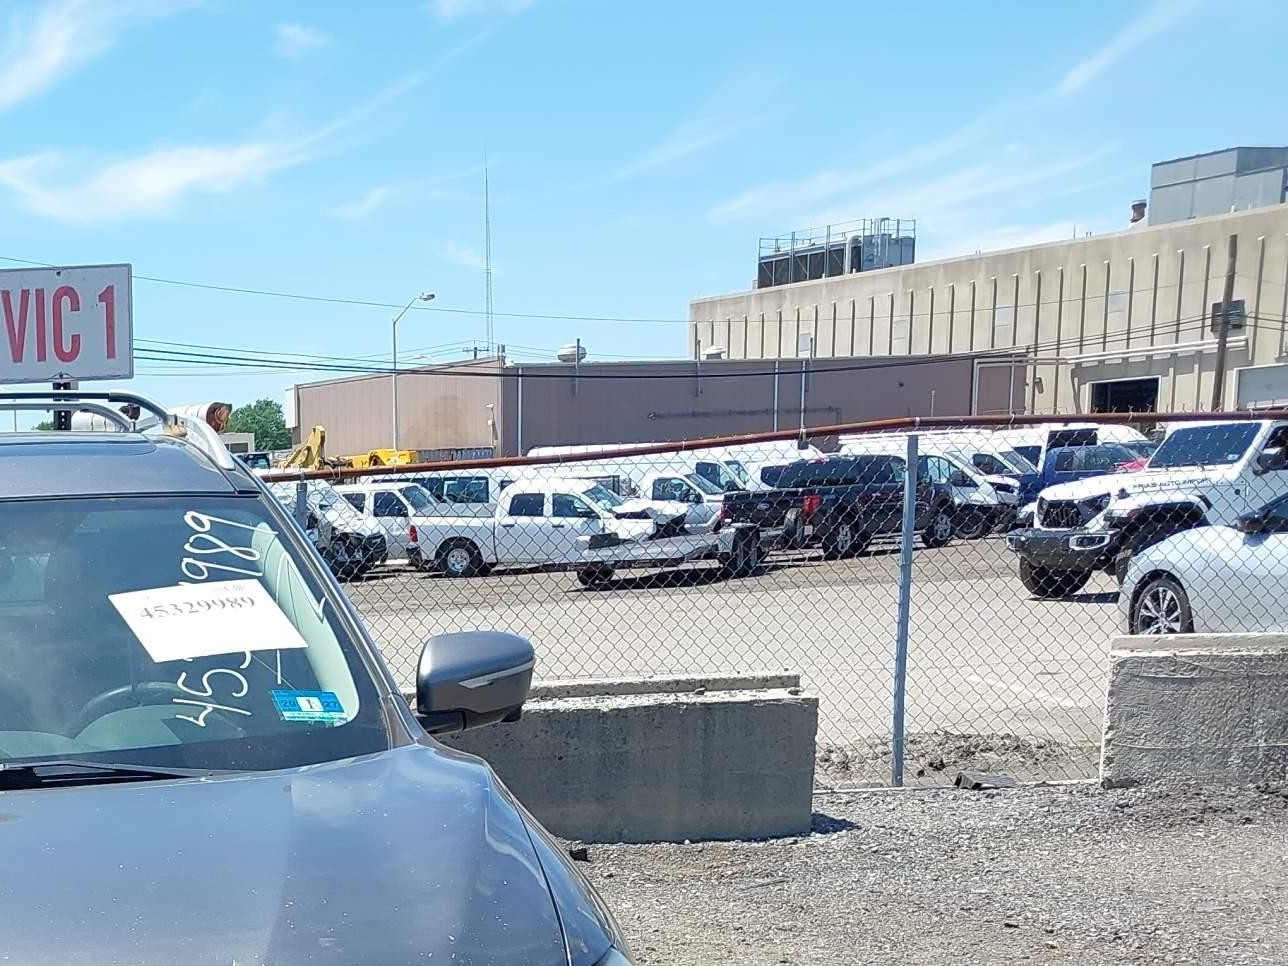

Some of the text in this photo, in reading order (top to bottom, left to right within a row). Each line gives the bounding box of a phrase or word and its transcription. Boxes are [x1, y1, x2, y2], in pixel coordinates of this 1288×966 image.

[0, 284, 116, 363] VIC 1
[139, 596, 256, 619] 45329989
